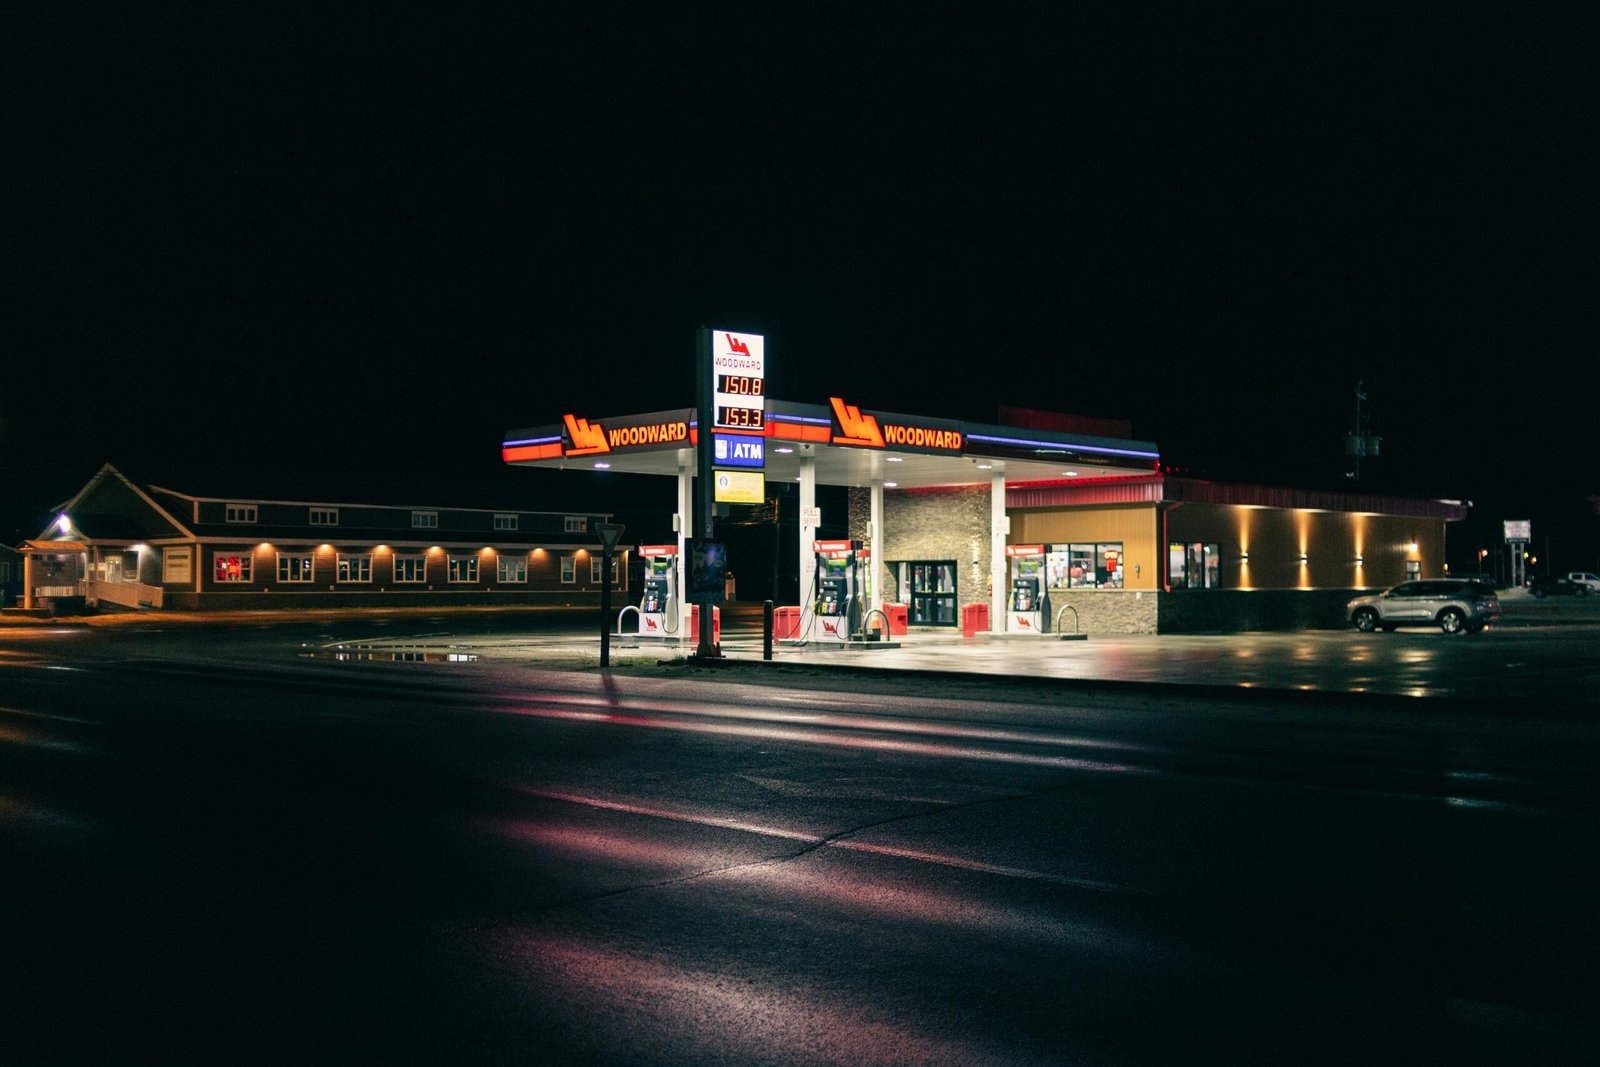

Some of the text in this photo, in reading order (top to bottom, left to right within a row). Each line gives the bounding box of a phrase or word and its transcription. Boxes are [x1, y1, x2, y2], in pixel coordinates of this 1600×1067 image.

[715, 357, 761, 371] WOODWARD
[725, 375, 762, 395] 150.8
[725, 407, 762, 427] 153.3
[609, 422, 687, 447] WOODWARD
[884, 424, 962, 449] WOODWARD
[733, 443, 762, 460] ATM
[804, 509, 818, 517] FULL
